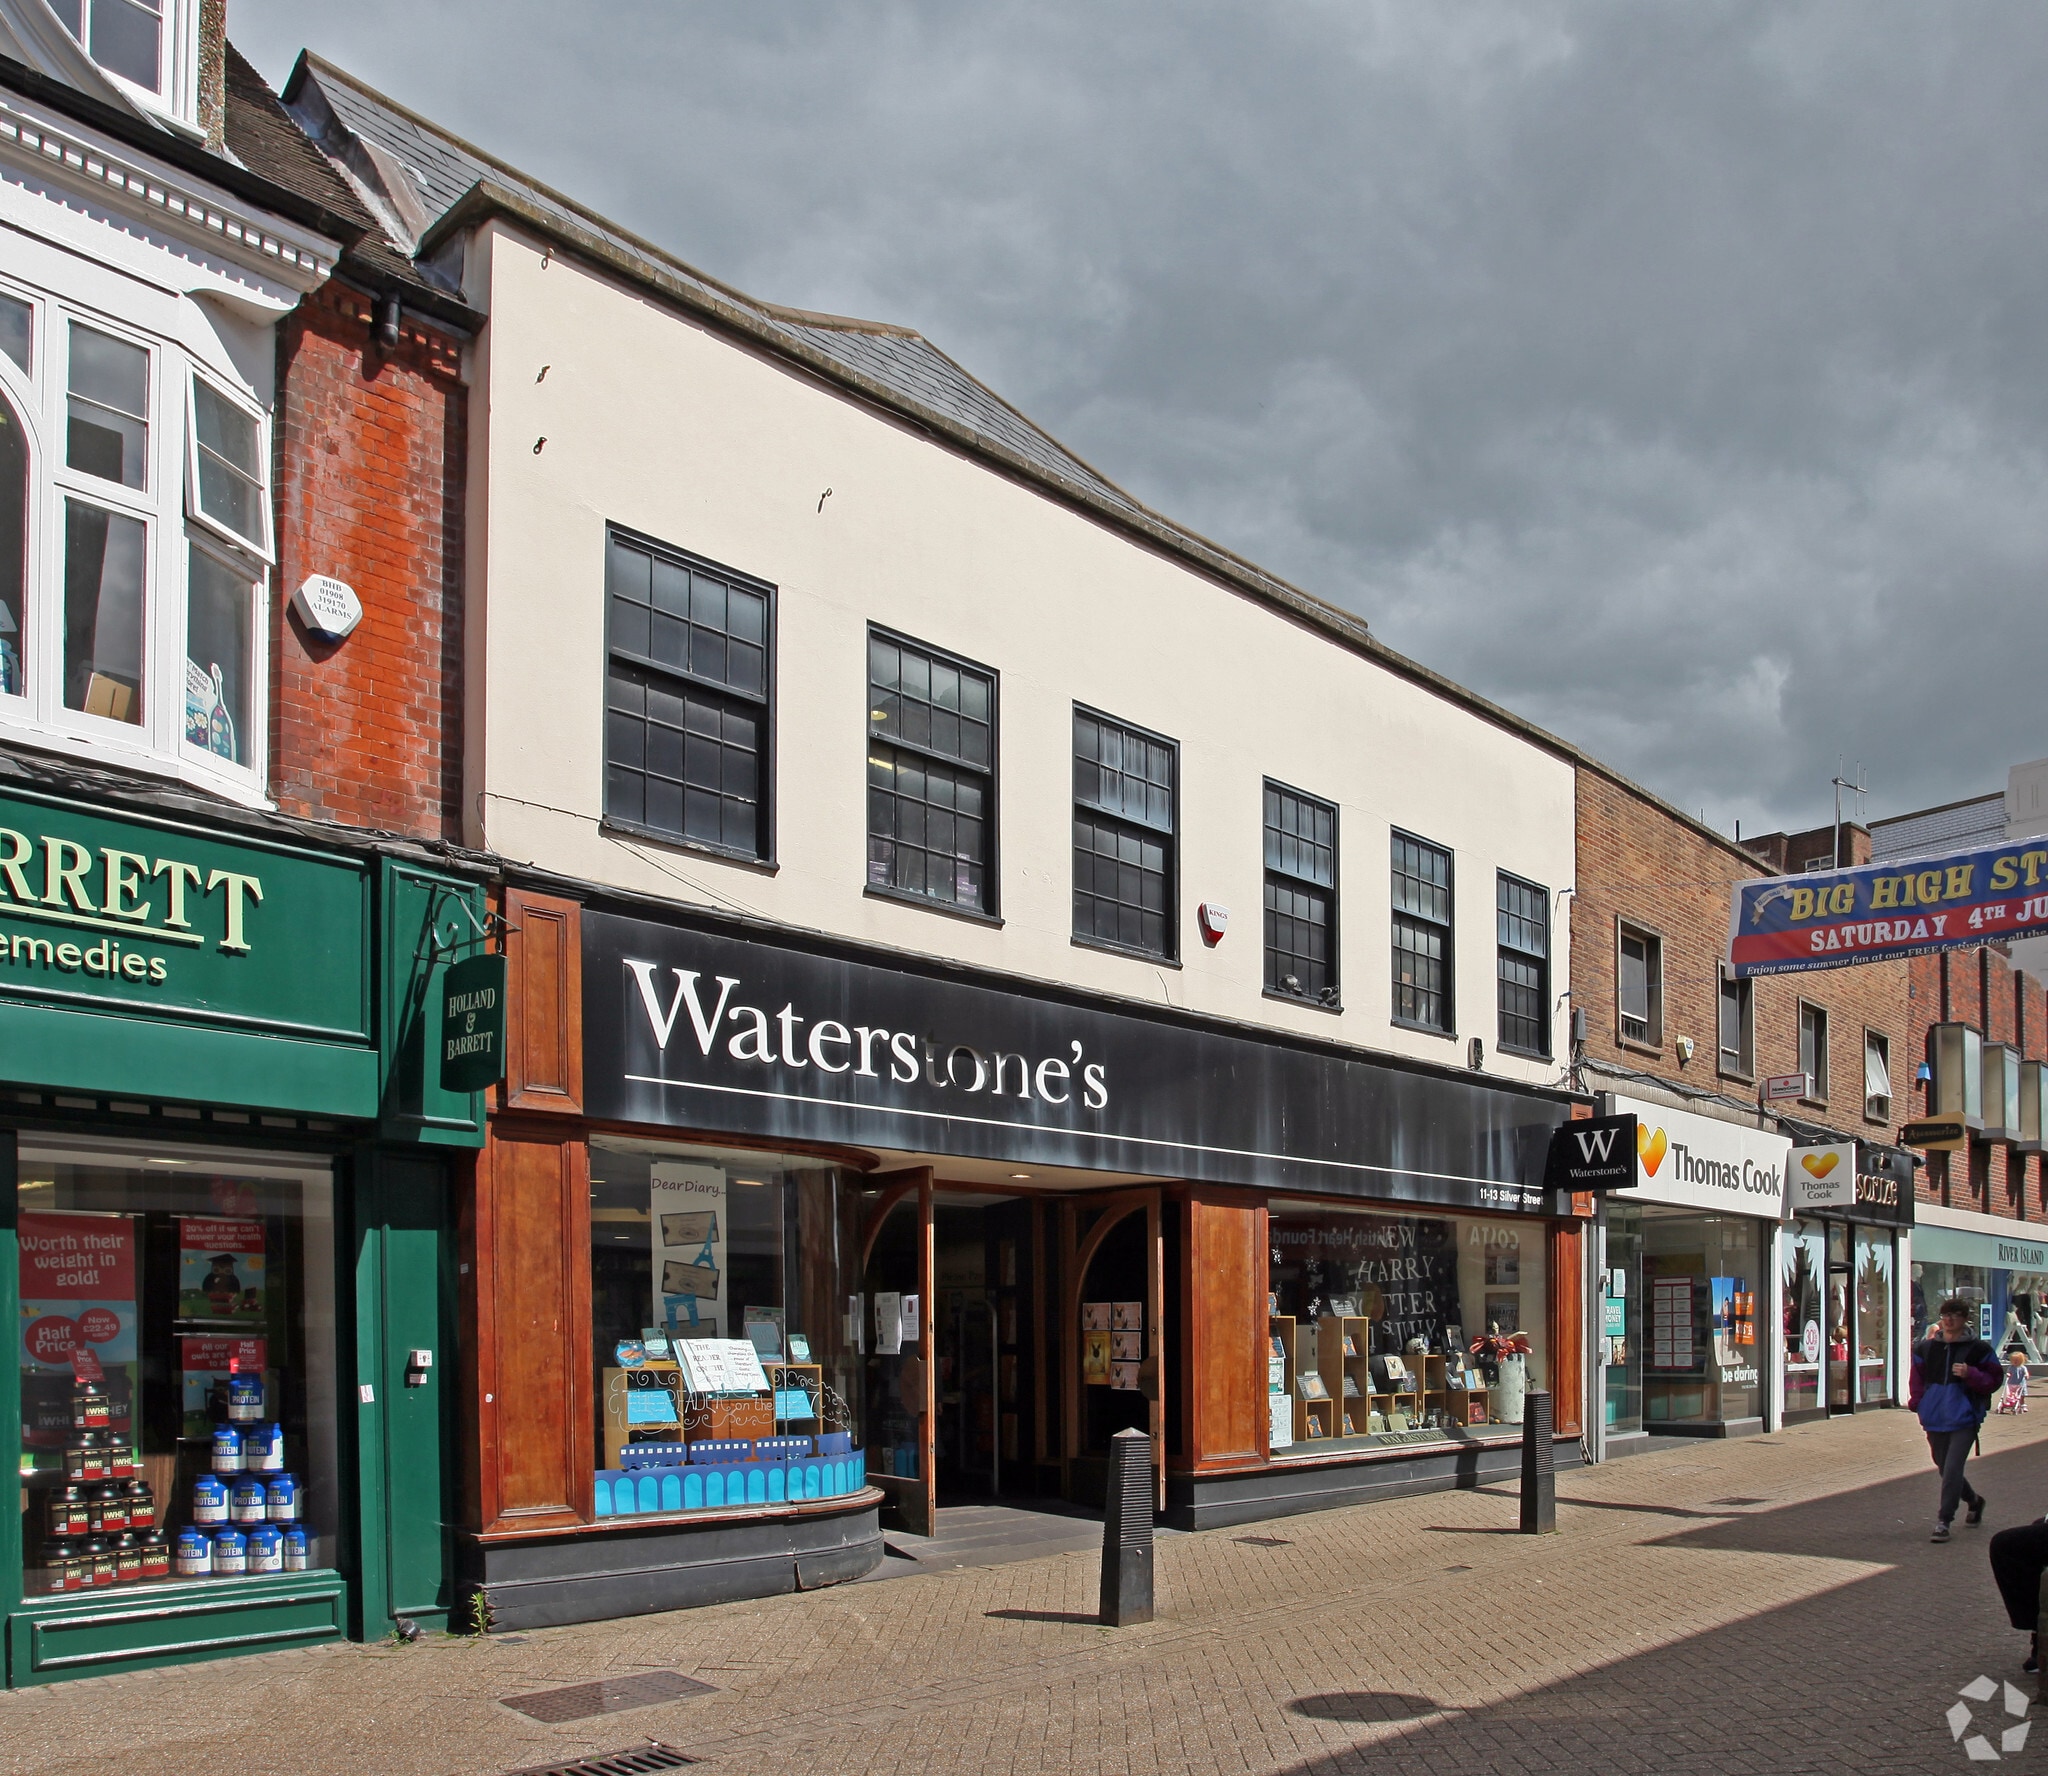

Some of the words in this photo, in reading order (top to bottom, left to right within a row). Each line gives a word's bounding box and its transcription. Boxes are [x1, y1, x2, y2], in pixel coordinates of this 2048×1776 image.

[317, 595, 346, 609] 319170
[320, 588, 343, 600] 01908
[312, 602, 352, 620] ALARMS
[1790, 883, 1855, 920] BIG
[1869, 864, 1975, 909] HIGH
[1990, 850, 2048, 890] ST
[1209, 909, 1228, 920] KINGS
[1811, 914, 1948, 952] SATURDAY
[1967, 904, 2007, 929] 4TH
[1746, 965, 1776, 976] Enjoy
[1778, 963, 1806, 972] some
[1807, 957, 1850, 969] summer
[1851, 954, 1869, 967] fun
[1871, 953, 1883, 961] at
[1885, 951, 1906, 959] our
[1907, 945, 1942, 955] FREE
[1941, 938, 1985, 952] festival
[1986, 936, 2006, 946] for
[2007, 931, 2024, 941] all
[2027, 928, 2047, 938] the
[448, 987, 496, 1018] HOLLAND
[465, 1012, 477, 1033] &
[622, 958, 1109, 1109] Waterstone's
[446, 1031, 494, 1060] BARRETT
[1573, 1127, 1620, 1165] W
[1569, 1164, 1627, 1178] Waterstone's
[1671, 1142, 1740, 1191] Thomas
[1743, 1158, 1781, 1197] Cook
[1800, 1181, 1840, 1191] Thomas
[1807, 1190, 1833, 1200] Cook
[1479, 1187, 1498, 1201] 11-13
[1499, 1191, 1521, 1203] Silver
[1522, 1193, 1544, 1206] Street
[20, 1234, 77, 1252] Worth
[82, 1233, 125, 1250] their
[1381, 1225, 1415, 1249] NEW
[34, 1252, 95, 1270] weight
[99, 1252, 117, 1267] in
[1998, 1243, 2019, 1263] RIVER
[2020, 1246, 2044, 1266] ISLAND
[56, 1270, 101, 1287] gold!
[1358, 1255, 1435, 1284] HARRY
[82, 1323, 117, 1333] £22.49
[87, 1316, 111, 1324] Now
[38, 1326, 72, 1341] Half
[35, 1340, 77, 1354] Price
[191, 1352, 210, 1360] owls
[202, 1343, 213, 1351] All
[1722, 1366, 1733, 1383] be
[1734, 1364, 1758, 1384] daring
[232, 1395, 260, 1404] PROTEIN
[735, 1402, 751, 1411] on
[754, 1394, 774, 1411] the
[234, 1496, 262, 1505] PROTEIN
